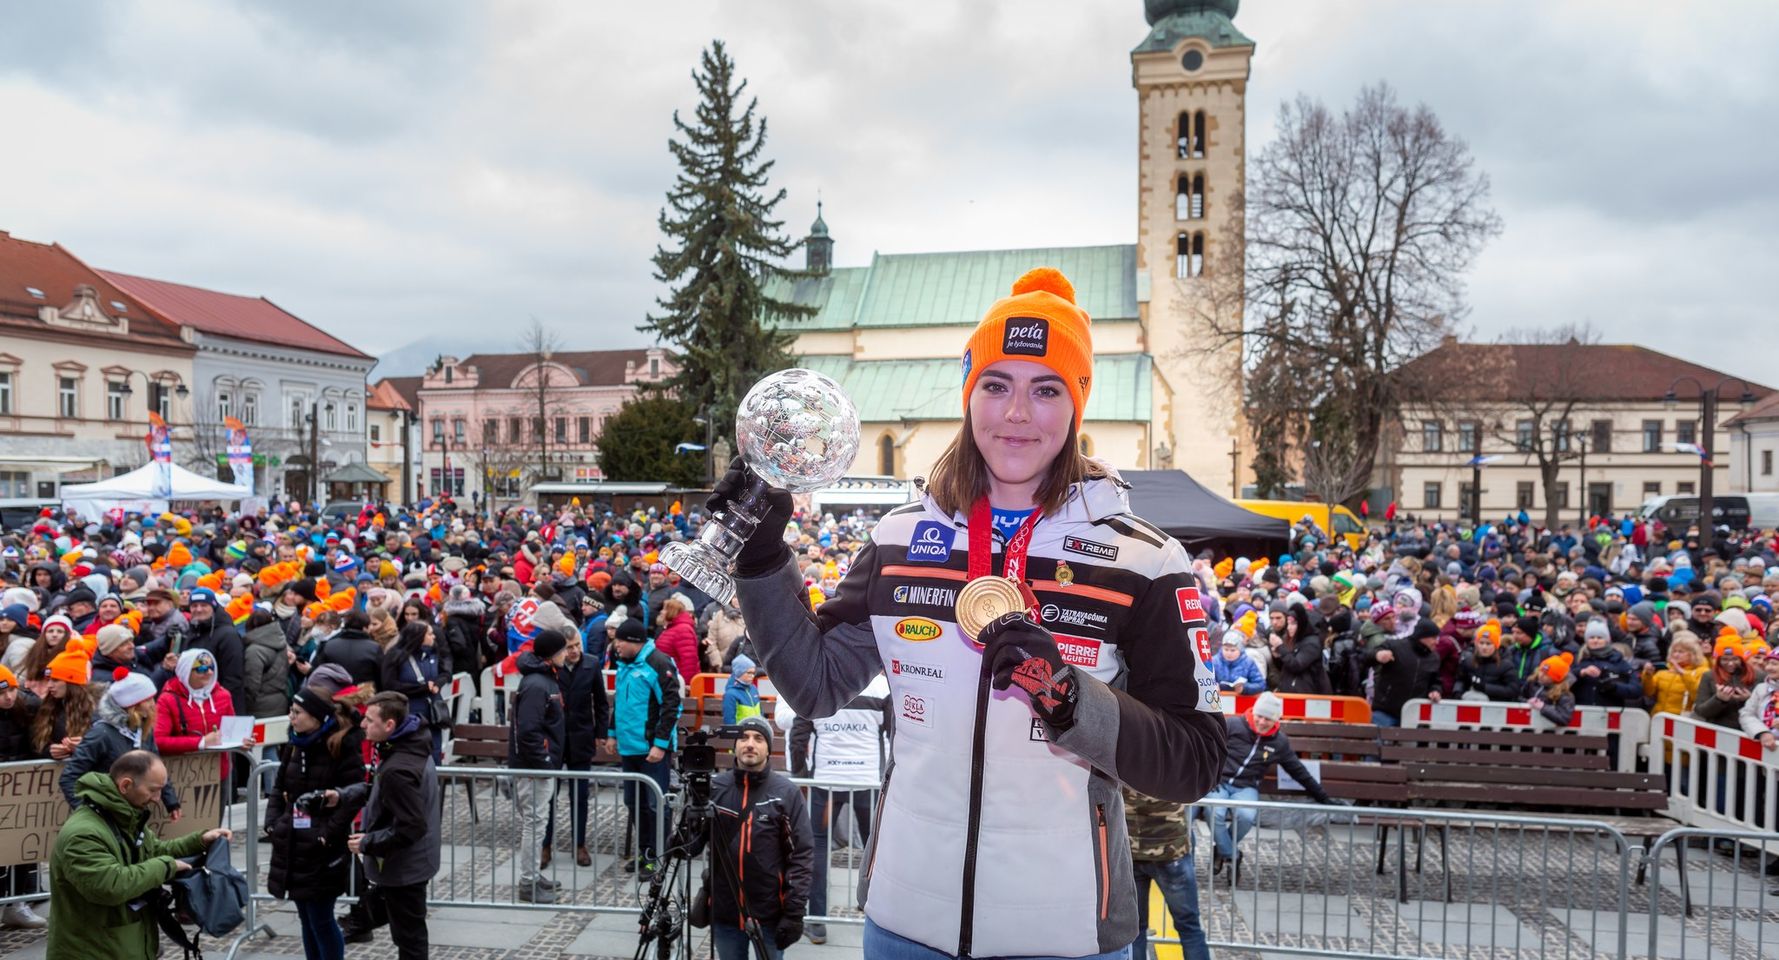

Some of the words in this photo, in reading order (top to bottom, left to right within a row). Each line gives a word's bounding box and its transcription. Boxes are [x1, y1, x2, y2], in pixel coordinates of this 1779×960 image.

[1008, 323, 1043, 340] peťa
[1006, 341, 1014, 349] je
[1014, 340, 1043, 350] lyžovanie
[910, 544, 947, 556] UNIQA
[1066, 539, 1116, 557] EXTREME
[908, 586, 957, 607] MINERFIN
[1060, 615, 1085, 625] POPRAD
[1061, 608, 1108, 624] TATRAVAGÓNKA
[905, 624, 937, 637] RAUCH
[1057, 642, 1098, 658] PIERRE
[1061, 654, 1096, 665] AGUETTE
[900, 664, 944, 679] KRONREAL
[824, 723, 869, 732] SLOVAKIA
